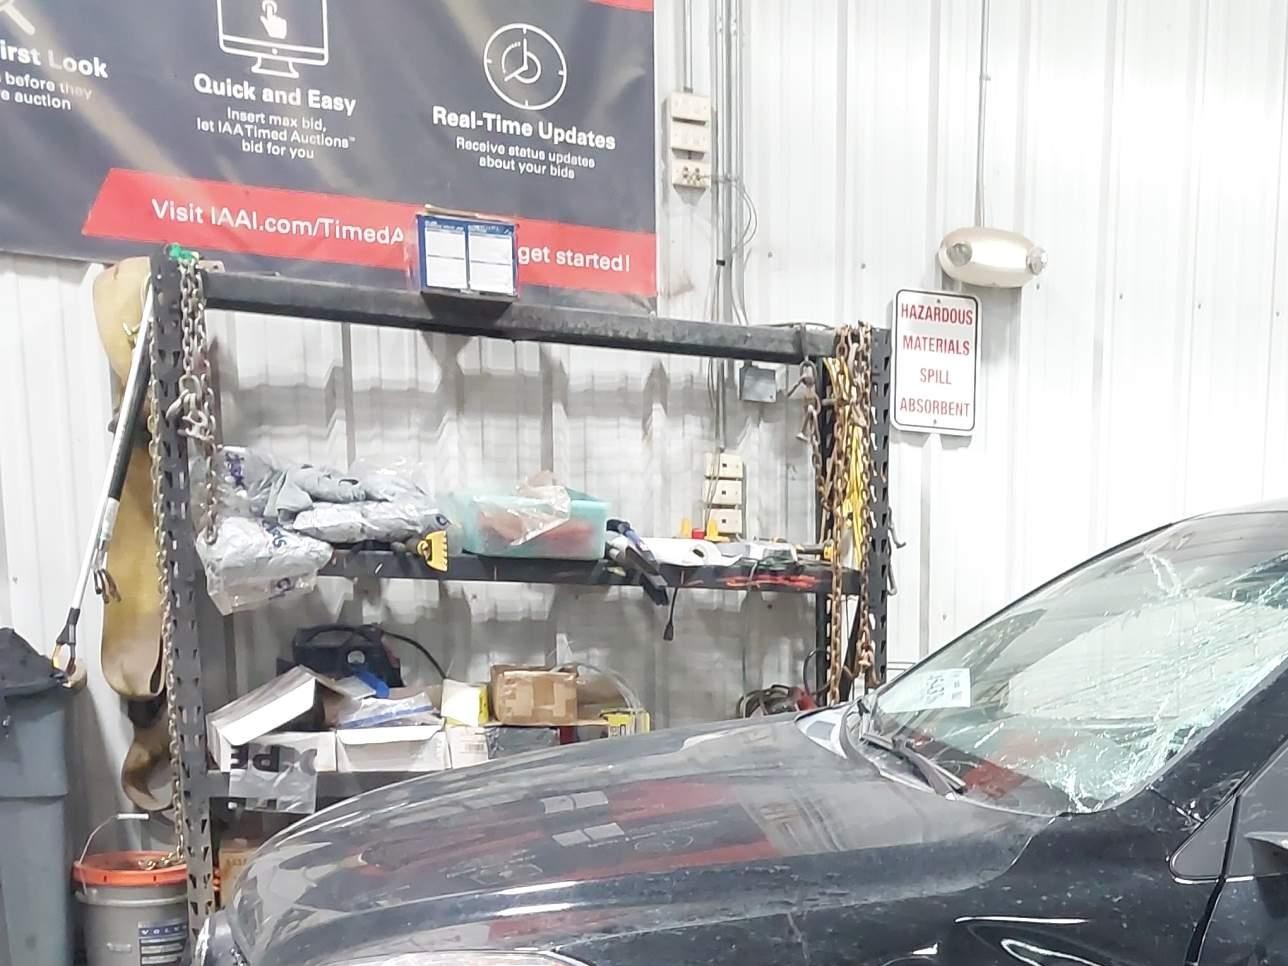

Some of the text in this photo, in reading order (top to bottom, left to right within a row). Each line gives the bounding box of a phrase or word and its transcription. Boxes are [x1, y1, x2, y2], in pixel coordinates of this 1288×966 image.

[0, 39, 108, 78] irst Look
[5, 71, 92, 100] before they
[193, 73, 356, 117] Quick and Easy
[14, 91, 71, 111] auction
[197, 117, 215, 133] let
[227, 107, 327, 133] Insert max bid,
[432, 105, 617, 150] Real-Time Updates
[241, 138, 315, 160] bid for you
[456, 136, 595, 169] Receive status updates
[479, 155, 575, 180] about your bids
[151, 198, 204, 224] Visit
[210, 205, 404, 245] IAAI.com/TimedA
[517, 246, 551, 265] get
[556, 249, 631, 273] started!
[901, 303, 973, 326] HAZARDOUS
[903, 335, 970, 356] MATERIALS
[920, 367, 952, 385] SPILL
[899, 397, 970, 417] ABSORBENT
